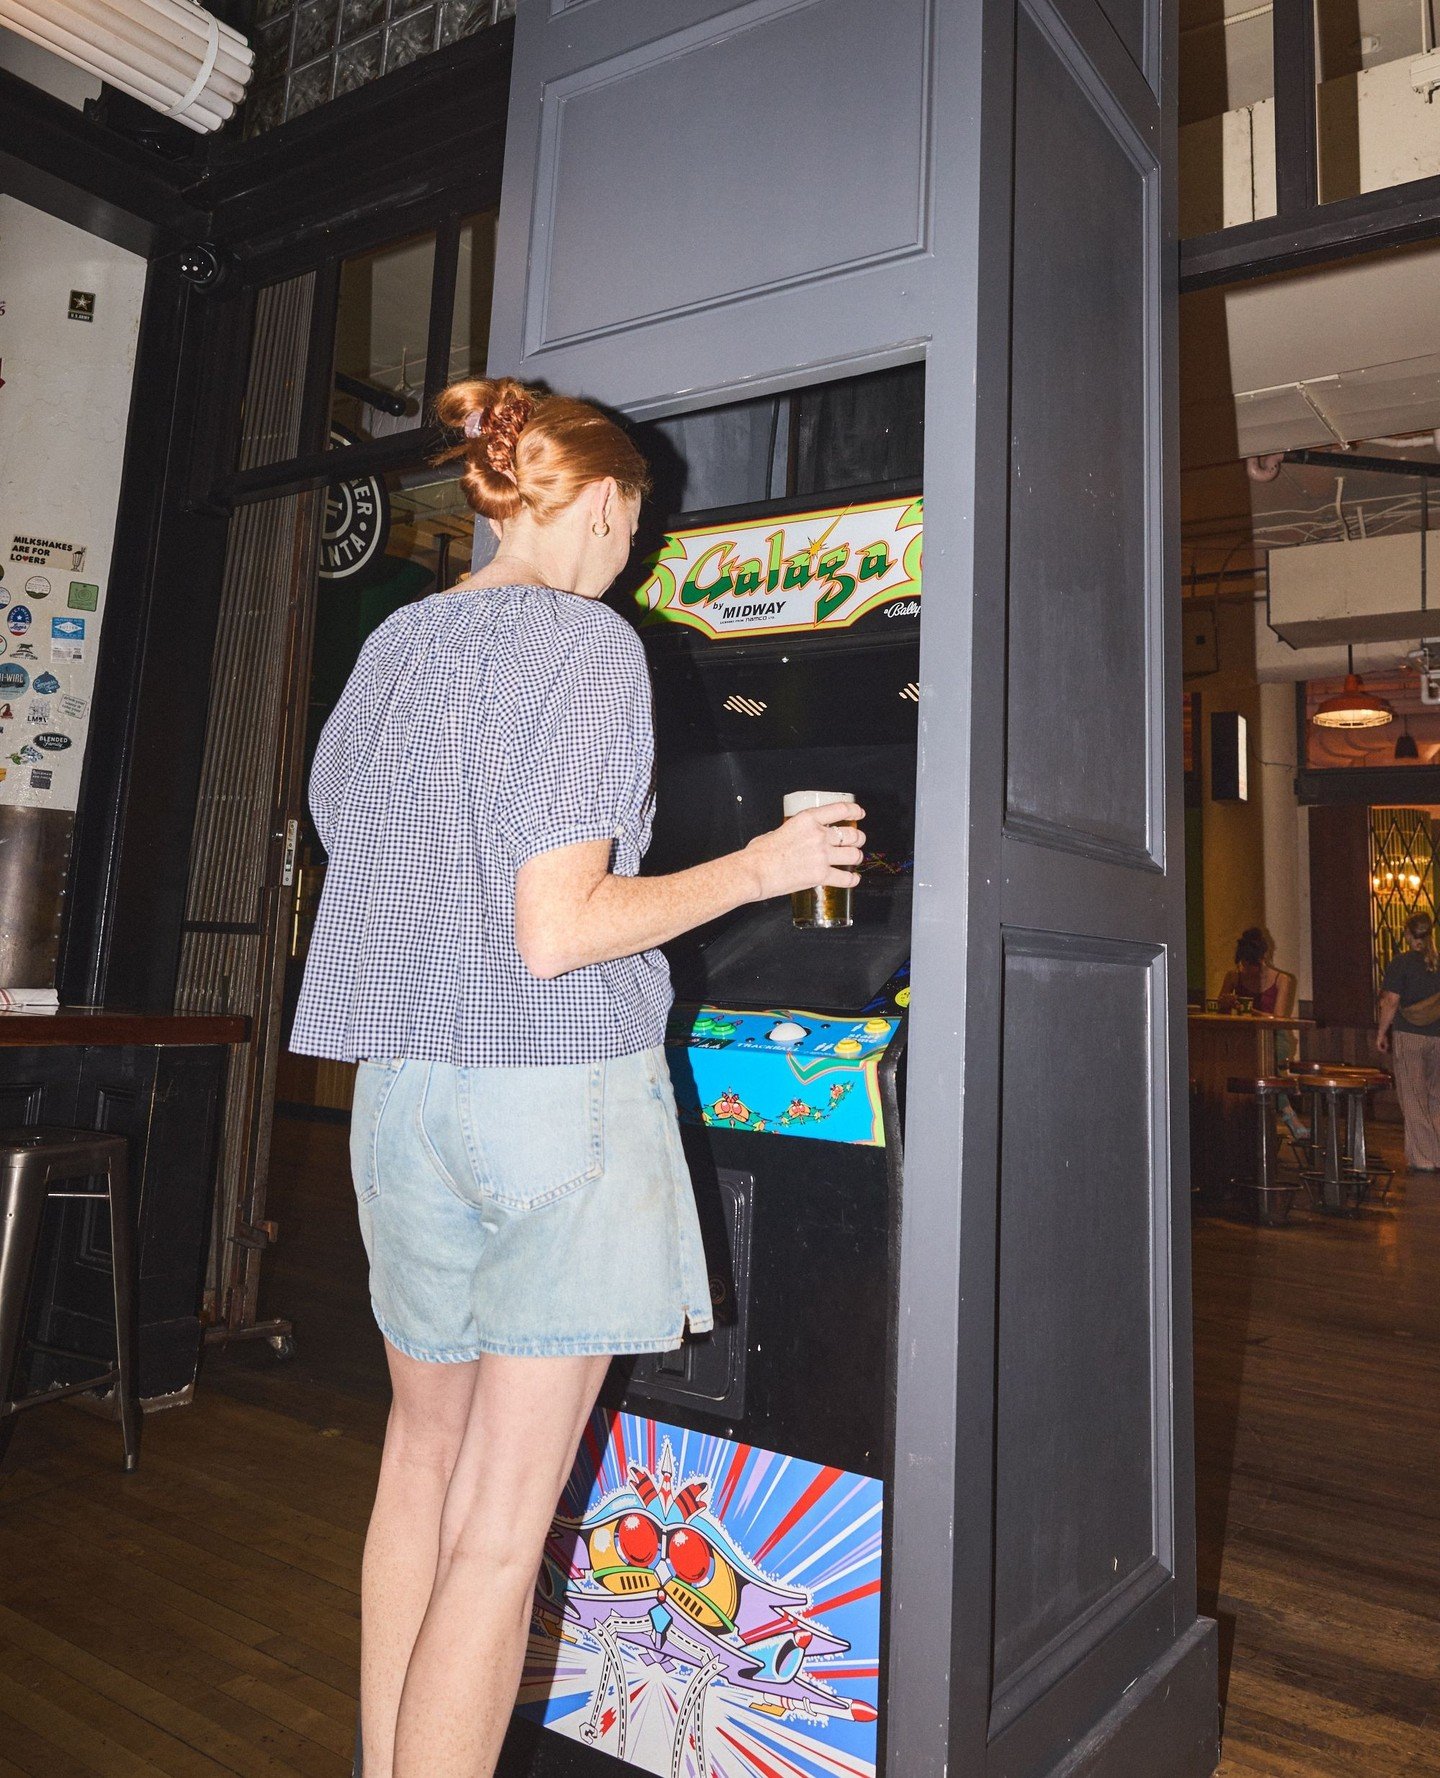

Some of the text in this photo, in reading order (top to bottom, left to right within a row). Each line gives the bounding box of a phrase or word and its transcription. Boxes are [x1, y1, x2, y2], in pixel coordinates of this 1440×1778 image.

[12, 545, 50, 556] ARE FOR
[13, 536, 73, 551] MILKSHAKES
[679, 528, 898, 627] Galaga
[712, 601, 787, 619] by MIDWAY
[887, 601, 921, 618] Bally
[39, 735, 68, 743] BLENDED
